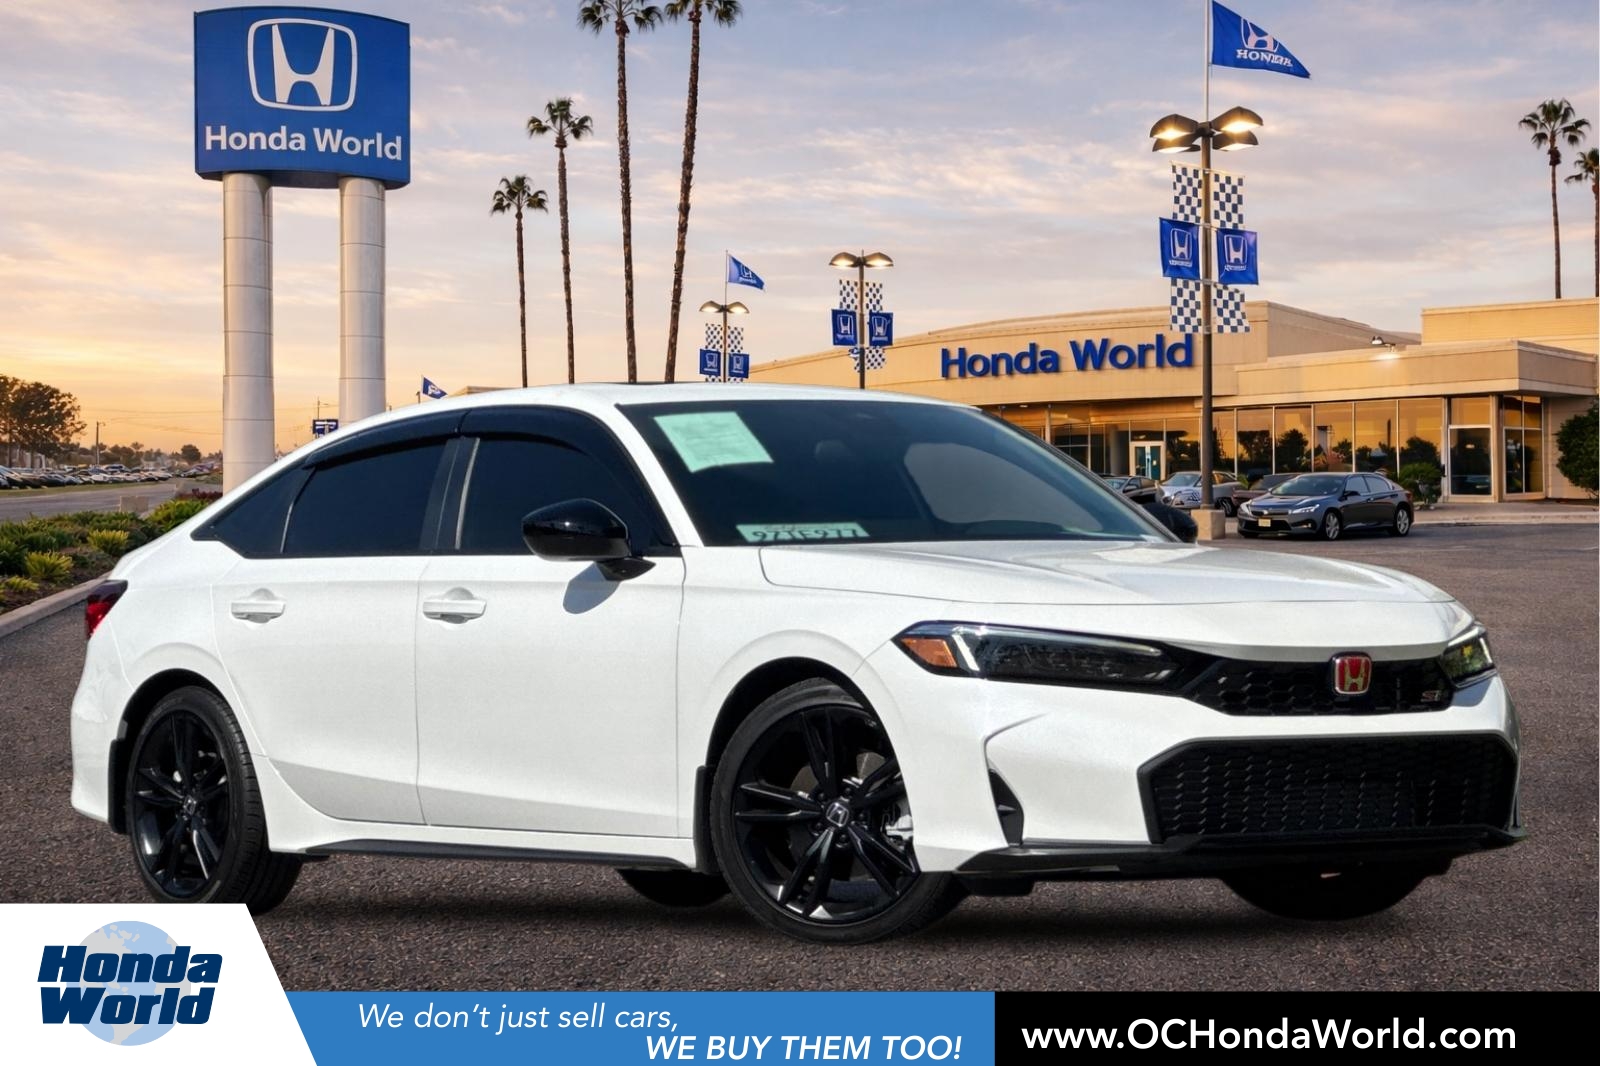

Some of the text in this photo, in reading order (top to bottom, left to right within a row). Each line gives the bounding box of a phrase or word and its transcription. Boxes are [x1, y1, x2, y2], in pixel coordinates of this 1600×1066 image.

[205, 124, 402, 161] Honda World
[941, 333, 1193, 378] Honda World
